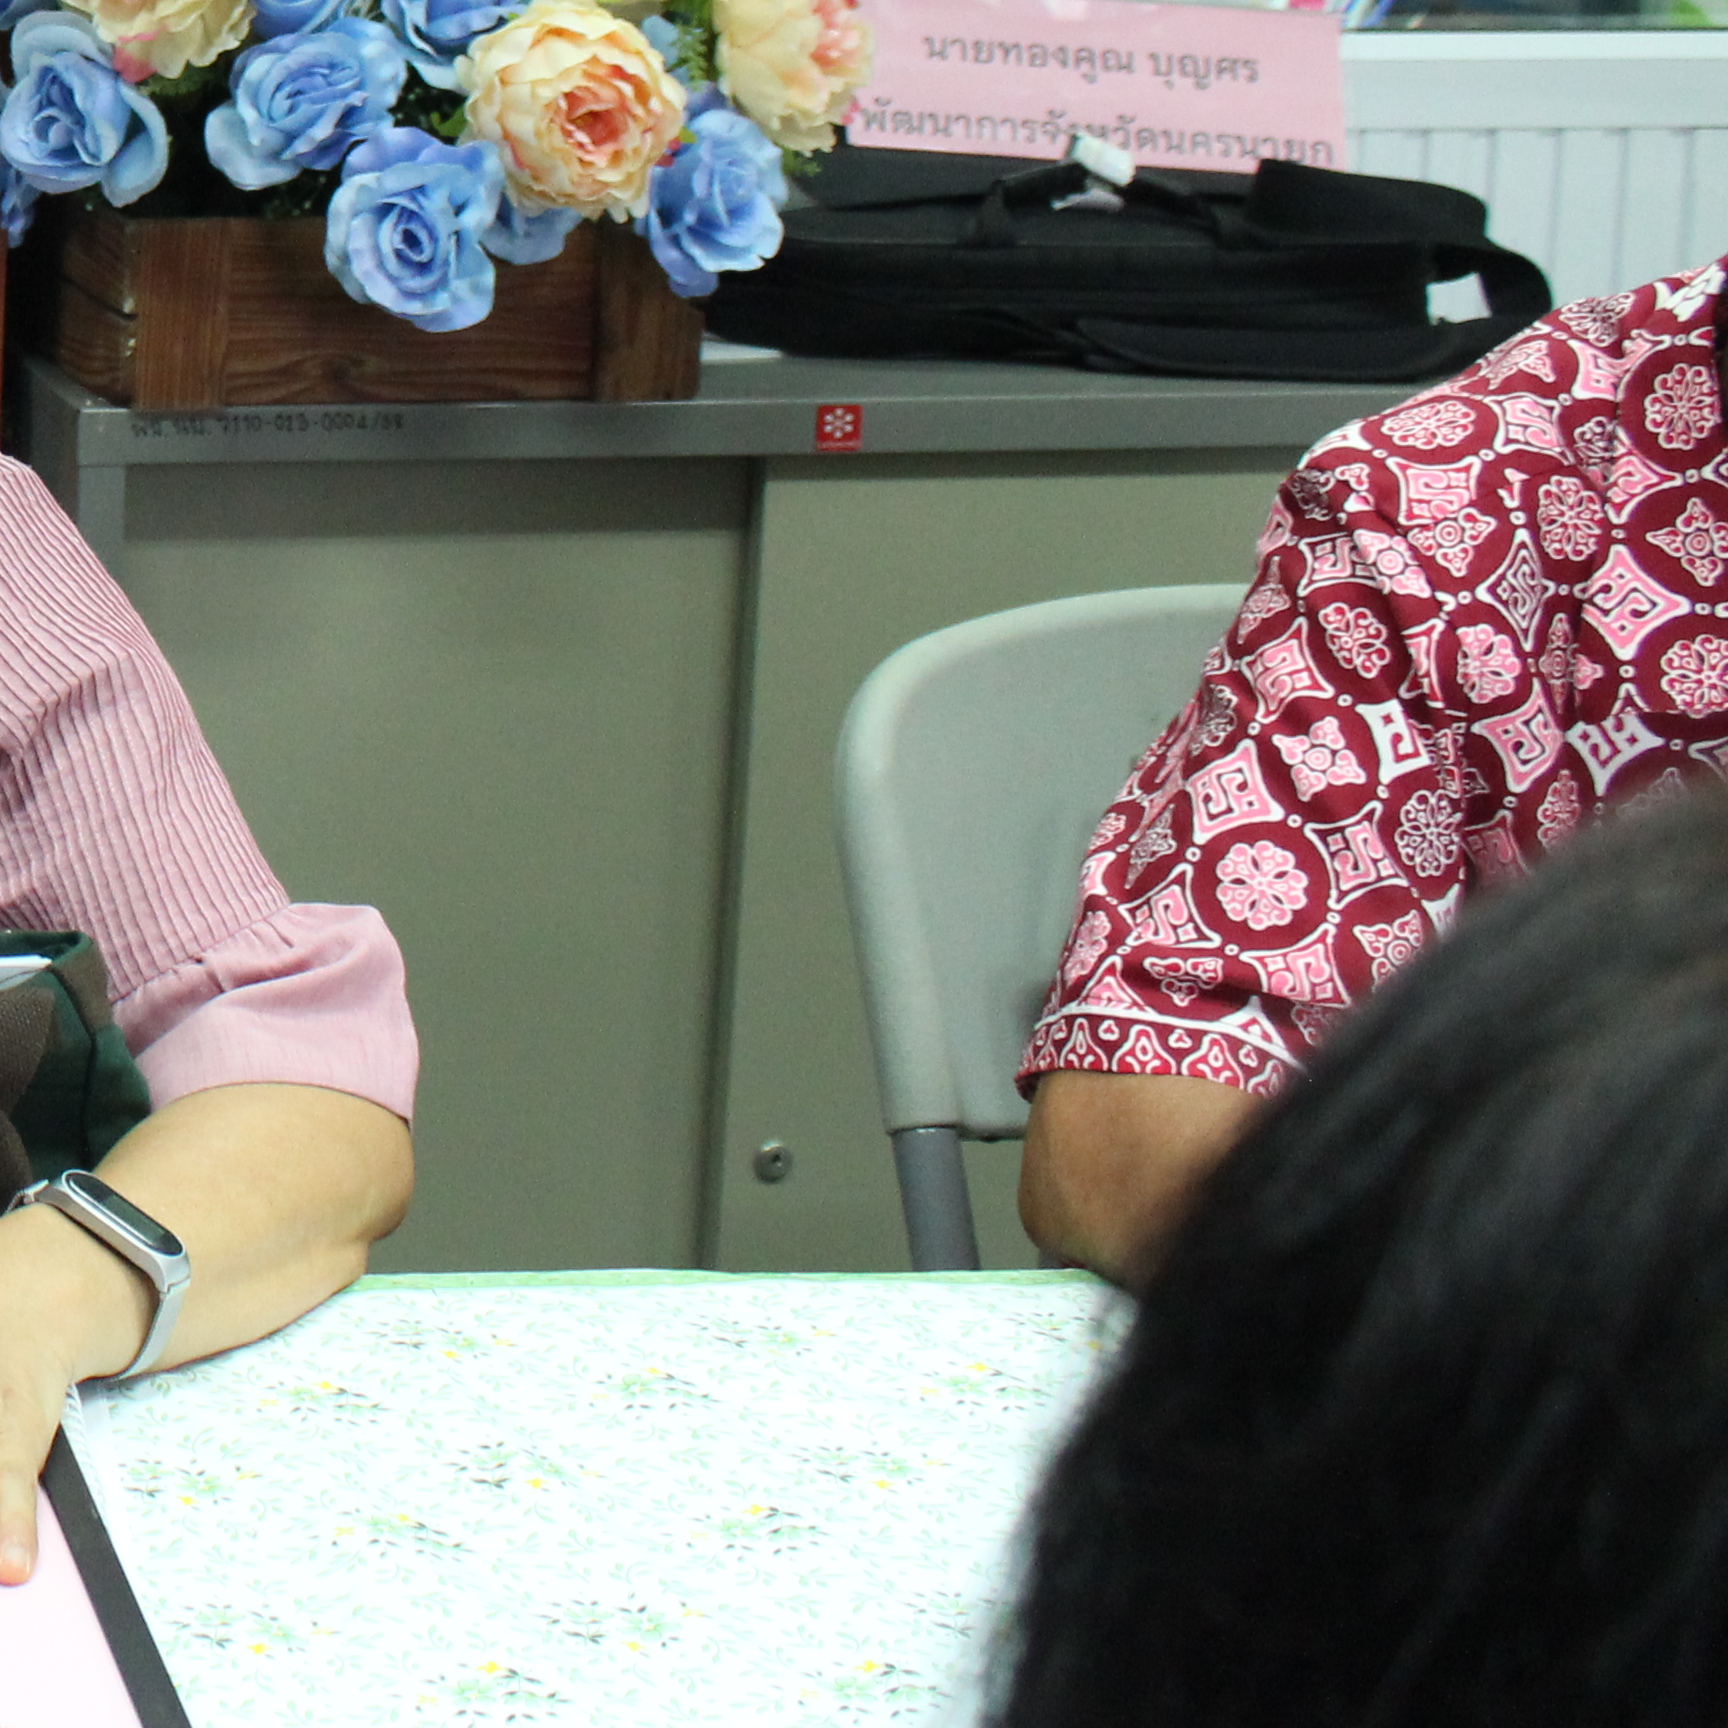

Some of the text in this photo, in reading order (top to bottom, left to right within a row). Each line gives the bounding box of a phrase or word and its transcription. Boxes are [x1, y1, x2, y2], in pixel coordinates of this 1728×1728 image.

[924, 32, 1260, 90] นายทองคูณ บุญศร
